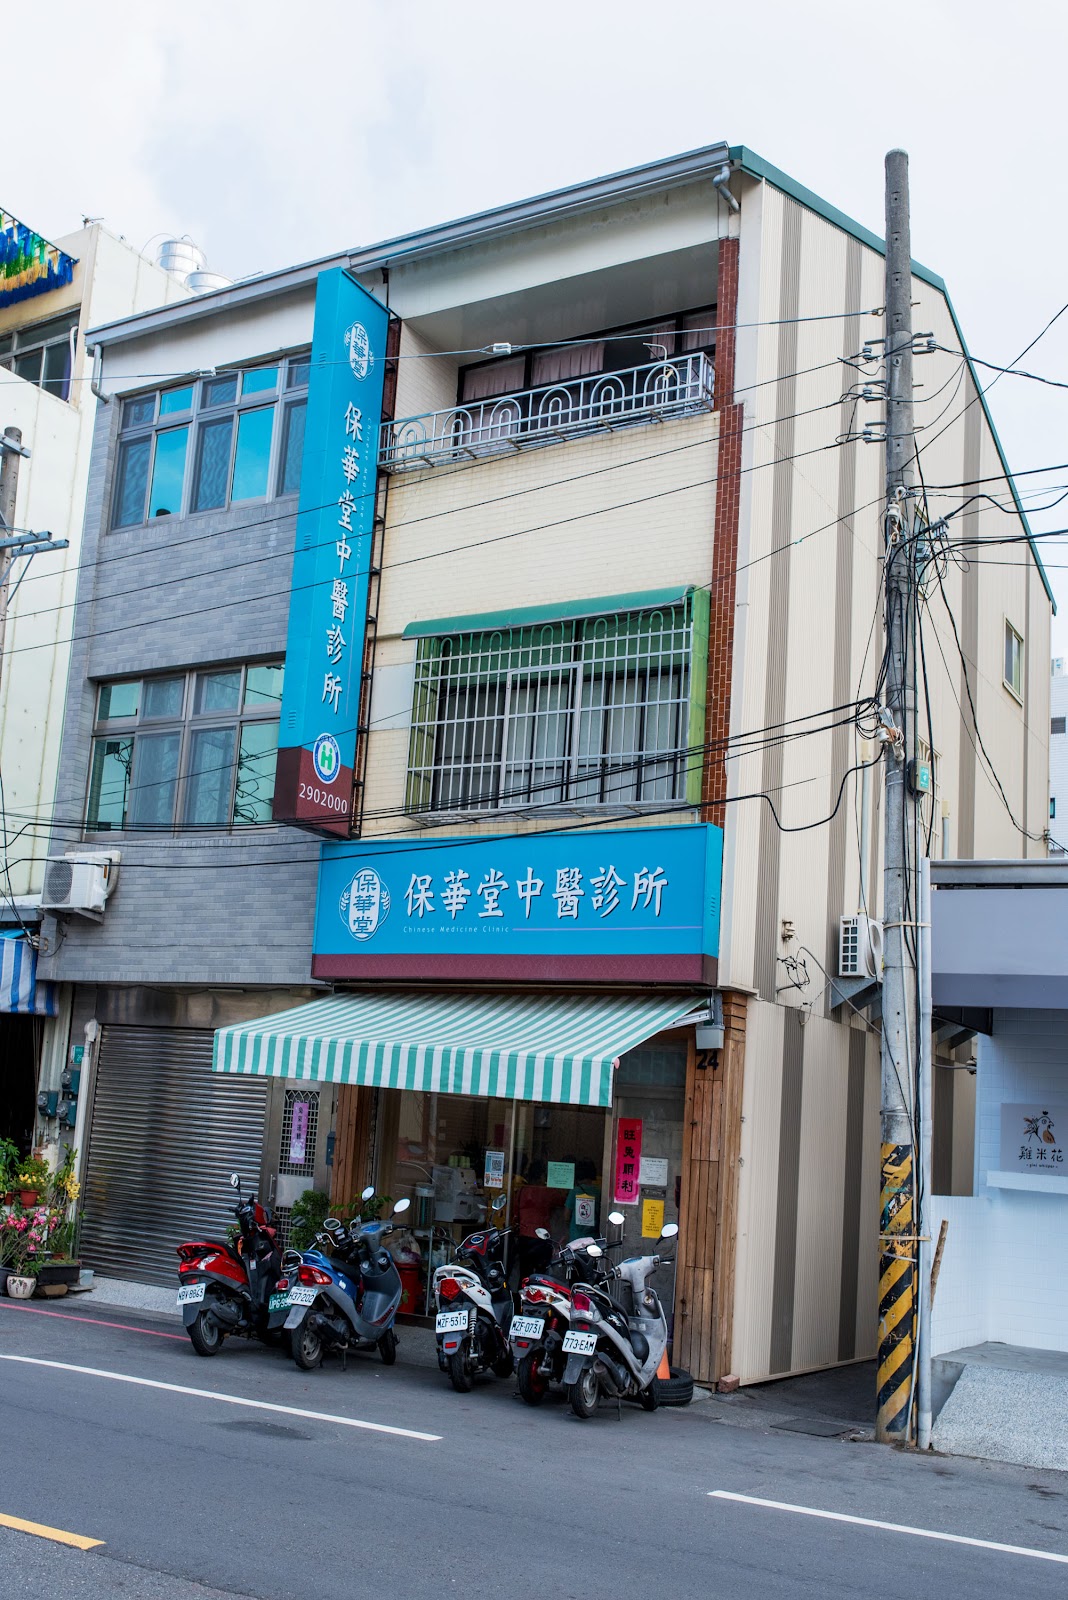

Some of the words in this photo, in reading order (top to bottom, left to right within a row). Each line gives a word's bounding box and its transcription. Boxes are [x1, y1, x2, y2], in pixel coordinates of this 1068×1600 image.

[351, 325, 368, 379] 保華堂
[356, 524, 364, 559] Clinic
[321, 400, 363, 714] 保華堂中醫診所
[298, 783, 348, 815] 2902000
[352, 873, 377, 934] 保華堂
[403, 864, 669, 920] 保華堂中醫診所
[440, 925, 478, 933] Medicine
[482, 925, 510, 933] Clinic
[696, 1050, 719, 1071] 24
[1018, 1146, 1064, 1163] 雞米花
[437, 1315, 467, 1329] MZF-5315
[511, 1320, 541, 1335] MZF-0731
[565, 1337, 594, 1352] 773-EAM
